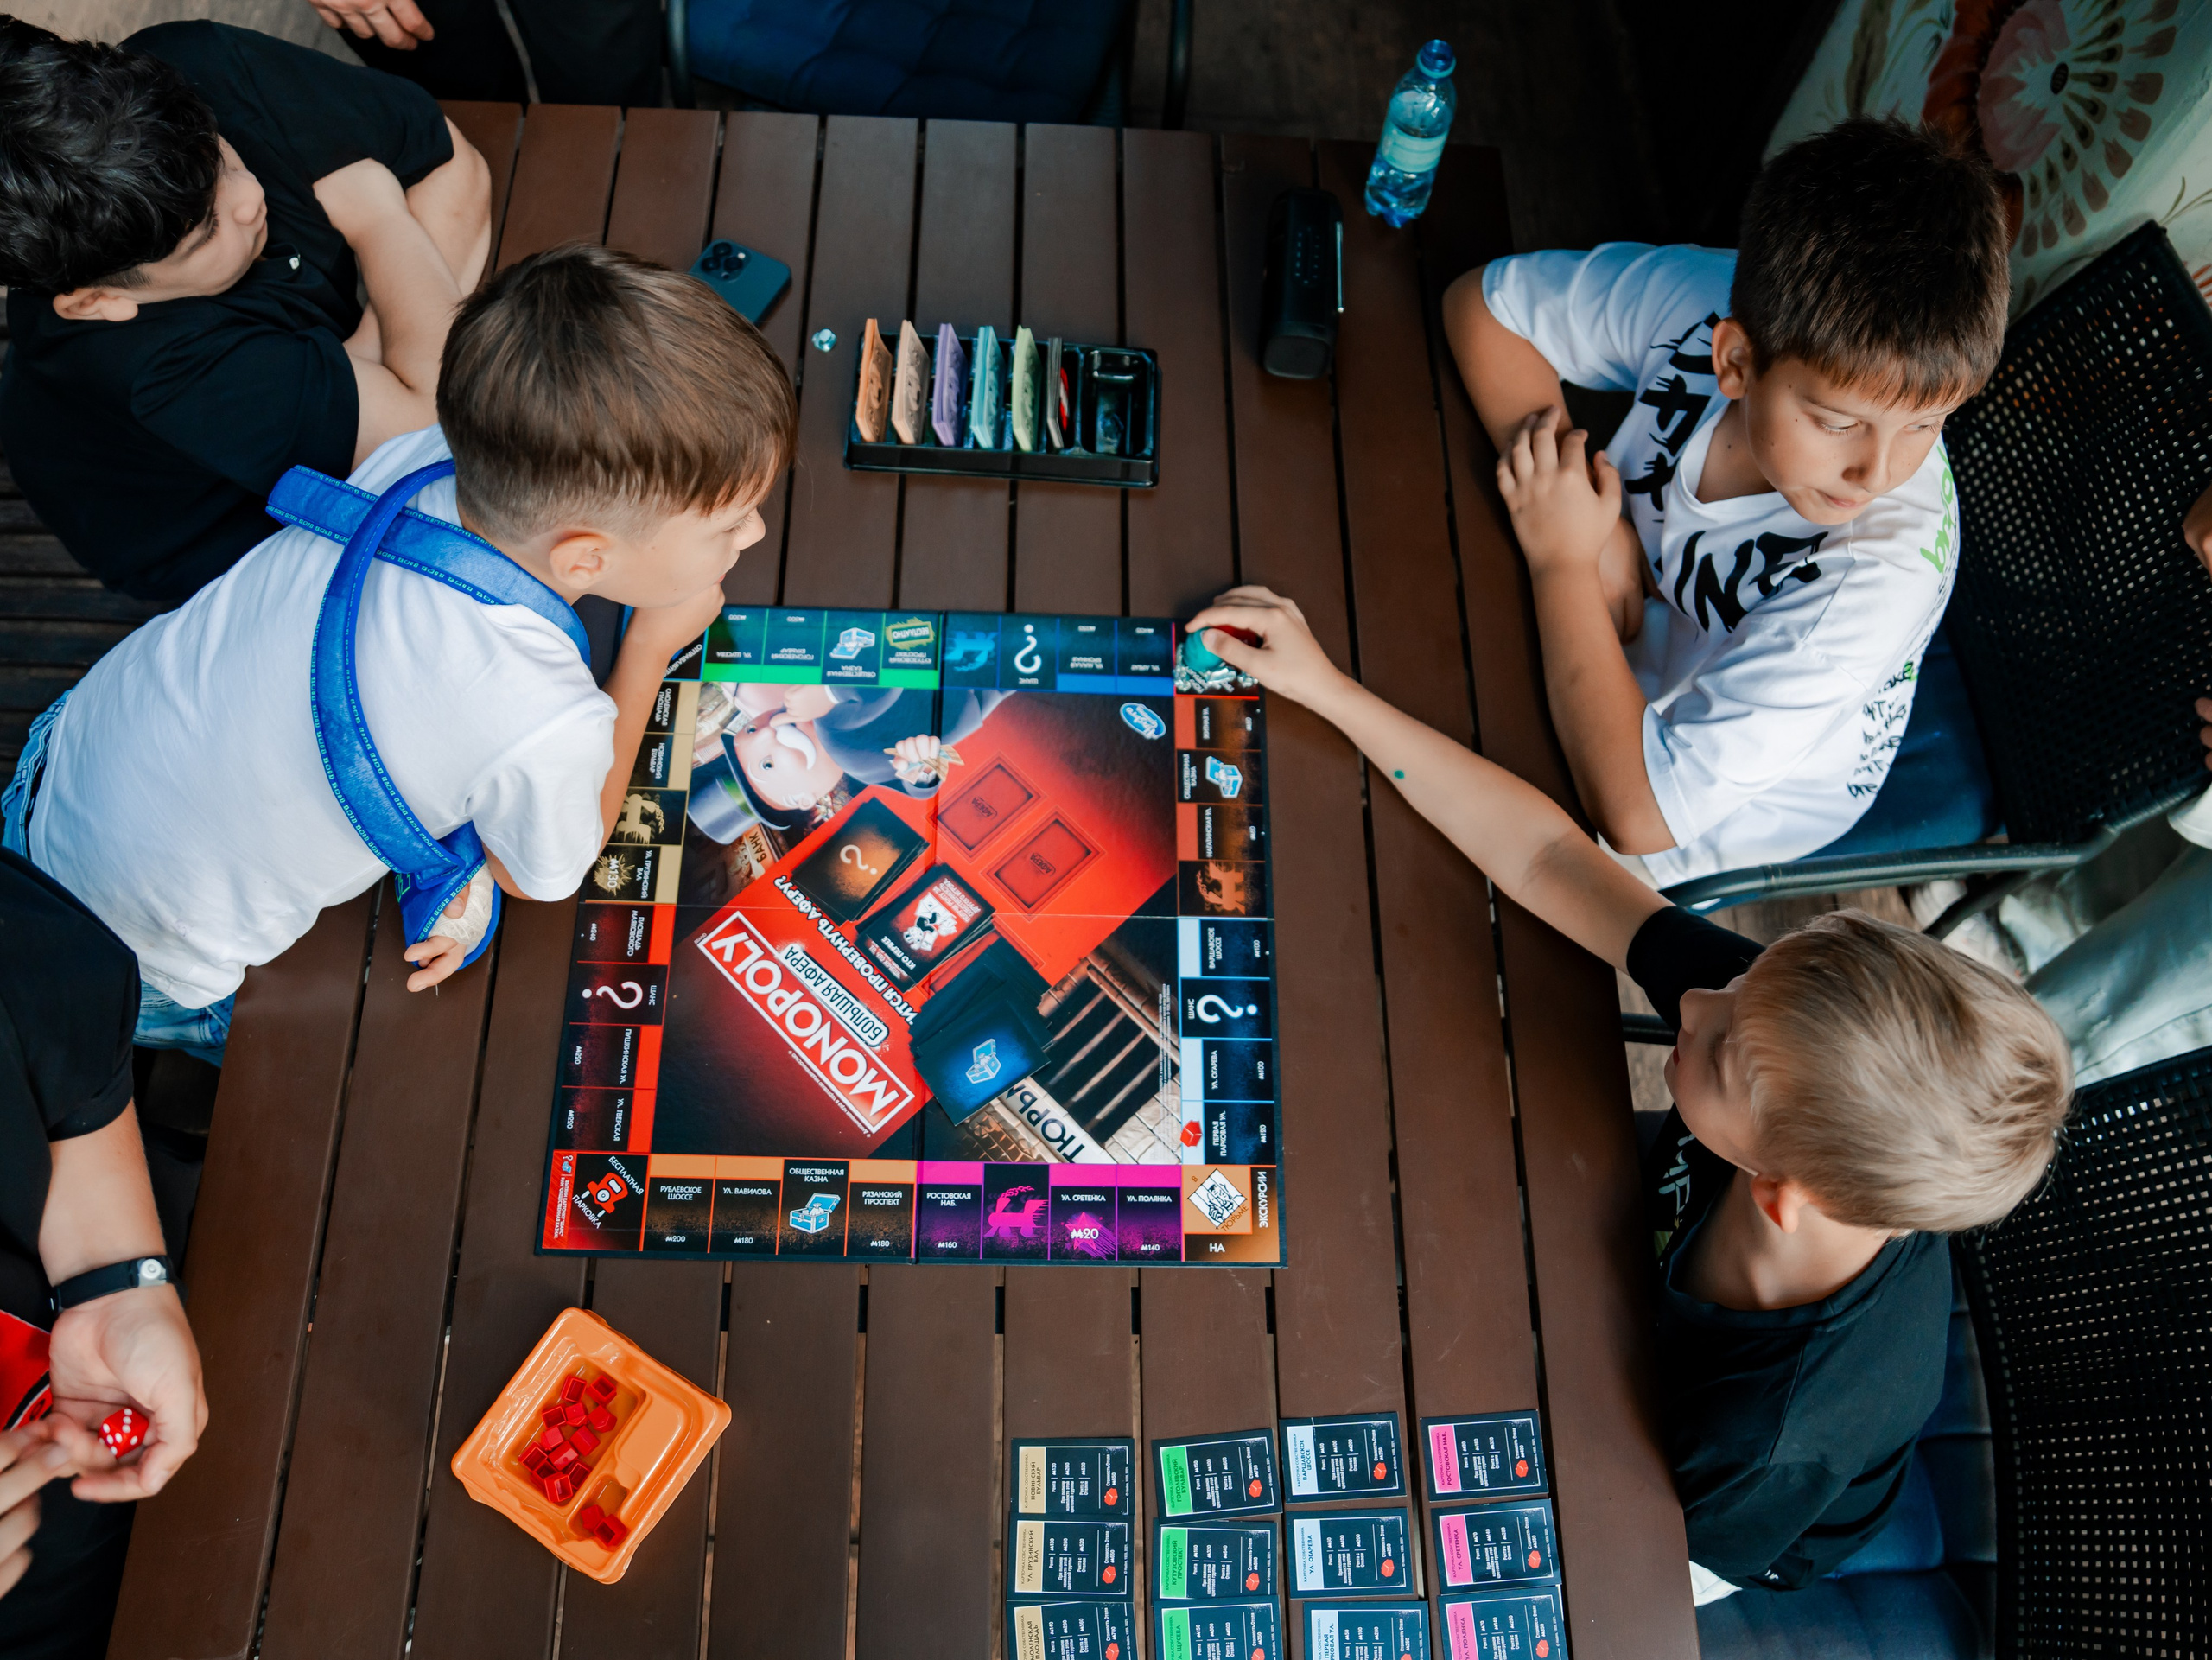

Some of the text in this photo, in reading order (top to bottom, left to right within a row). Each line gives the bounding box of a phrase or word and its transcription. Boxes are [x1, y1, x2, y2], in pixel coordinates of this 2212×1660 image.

[893, 627, 930, 639] БЕСПЛАТНО
[1182, 754, 1191, 799] ОБЩЕСТВЕННАЯ
[749, 831, 767, 863] БАНК
[627, 910, 638, 957] МАЯКОВСКОГО
[634, 916, 645, 951] ПЛОЩАДЬ
[774, 875, 918, 1026] ИТСЯ ПРОВЕРНУТЬ АФЕРУ?
[880, 935, 918, 970] КТО ПЕРВЕЕ
[783, 945, 884, 1041] БОЛЬШАЯ АФЕРА
[711, 932, 899, 1117] MONOPOLY
[620, 1028, 632, 1073] ПУШКИНСКАЯ
[613, 1110, 623, 1142] ТВЕРСКАЯ
[608, 1155, 644, 1195] БЕСПЛАТНАЯ
[789, 1167, 844, 1176] ОБЩЕСТВЕННАЯ
[572, 1194, 601, 1229] ПАРКОВКА
[862, 1190, 902, 1199] РЯЗАНСКИЙ
[926, 1192, 971, 1200] РОСТОВСКАЯ
[1259, 1171, 1268, 1228] ЭКСКУРСИИ
[1220, 1204, 1249, 1232] ТЮРЬМЕ
[1209, 1243, 1225, 1253] НА
